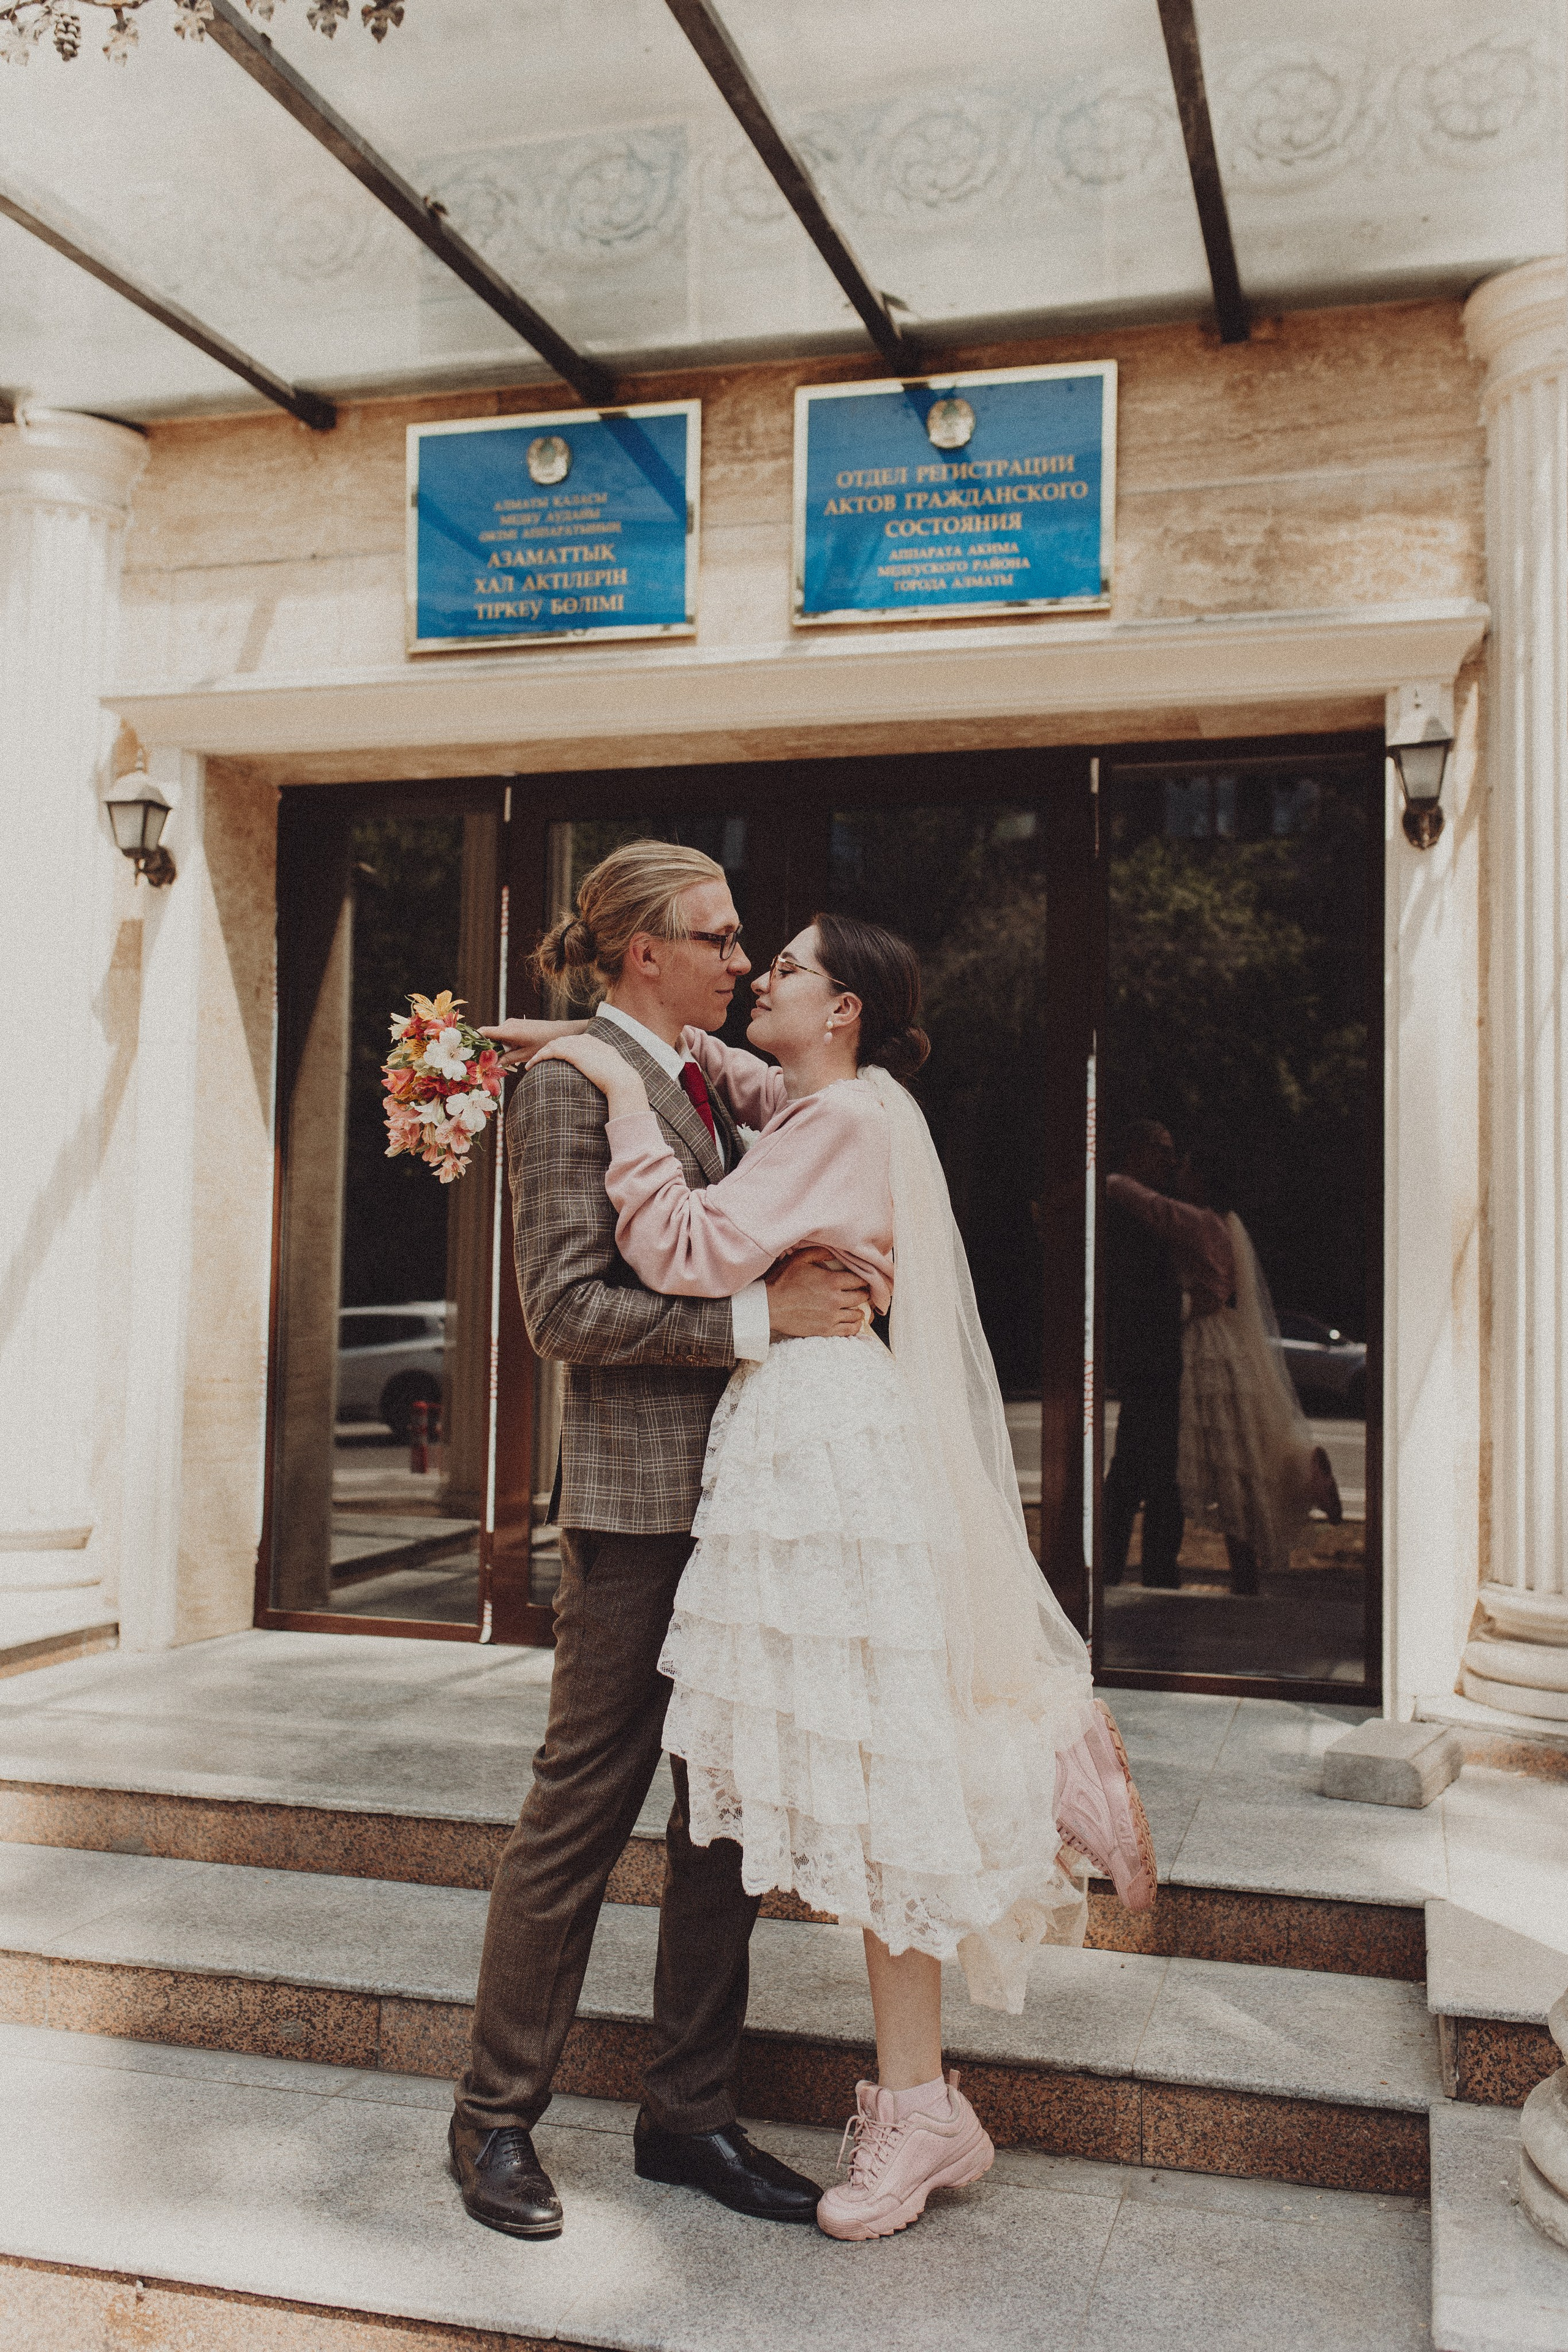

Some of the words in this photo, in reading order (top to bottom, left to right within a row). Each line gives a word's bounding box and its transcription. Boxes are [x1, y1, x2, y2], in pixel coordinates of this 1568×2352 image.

[837, 466, 906, 489] ОТДЕЛ
[916, 456, 1074, 483] РЕГИСТРАЦИИ
[824, 494, 895, 515] АКТОВ
[905, 481, 1088, 510] ГРАЖДАНСКОГО
[885, 513, 1022, 538] СОСТОЯНИЯ
[487, 544, 616, 568] АЗАМАТТЫҚ
[474, 576, 514, 594] ХАЛ
[522, 568, 627, 592] АКТІЛЕРІН
[475, 600, 543, 620] ТІРКЕУ
[551, 594, 624, 614] БӨЛІМІ
